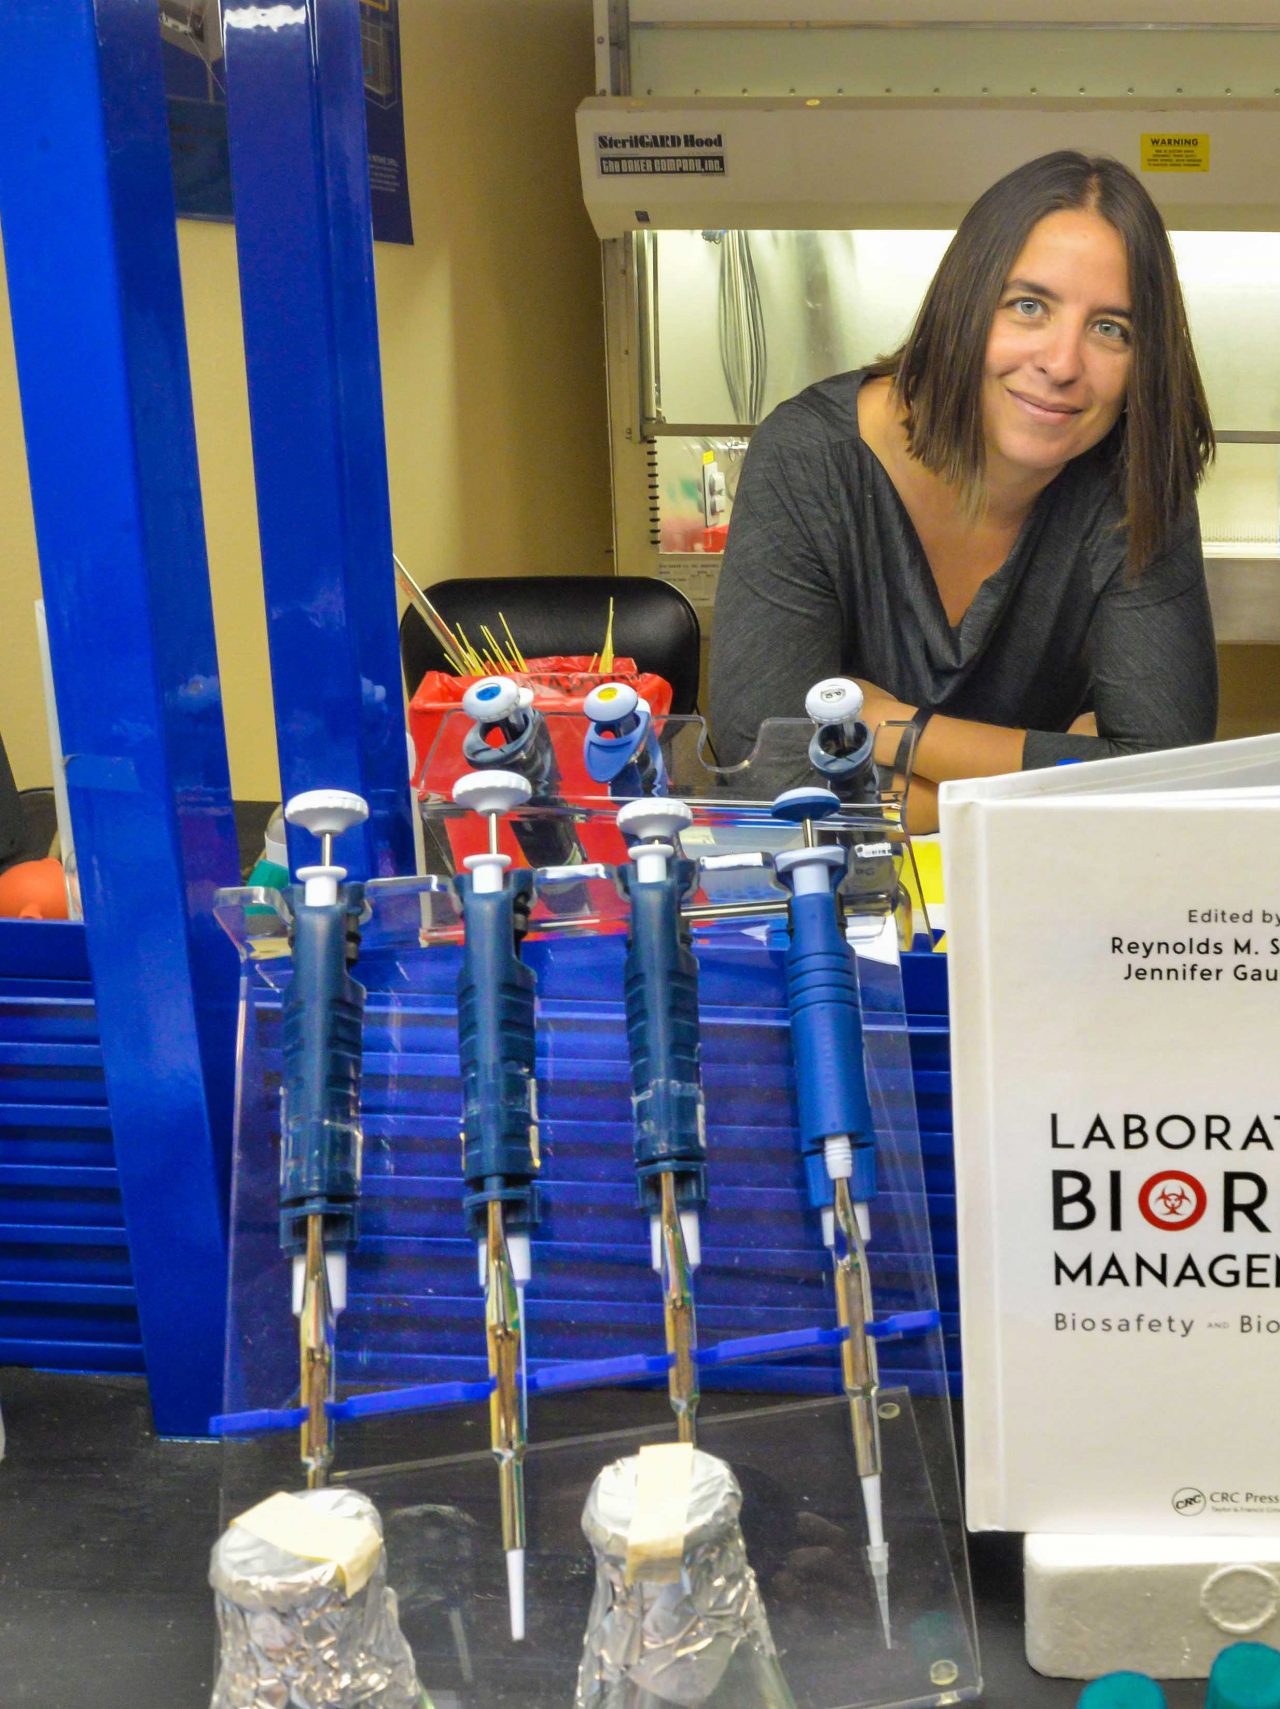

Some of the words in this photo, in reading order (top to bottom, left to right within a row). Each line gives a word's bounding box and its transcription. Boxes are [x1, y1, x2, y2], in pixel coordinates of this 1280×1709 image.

[598, 135, 681, 149] SterilGARD
[683, 134, 722, 148] Hood
[1151, 138, 1199, 147] WARNING
[1188, 909, 1253, 923] Edited
[1110, 937, 1223, 958] Reynolds
[1233, 938, 1259, 956] M.
[1123, 963, 1223, 981] Jennifer
[1054, 1313, 1194, 1337] Biosafety
[1176, 1494, 1201, 1510] CRC
[1209, 1492, 1240, 1503] CRC
[1245, 1492, 1280, 1503] Press
